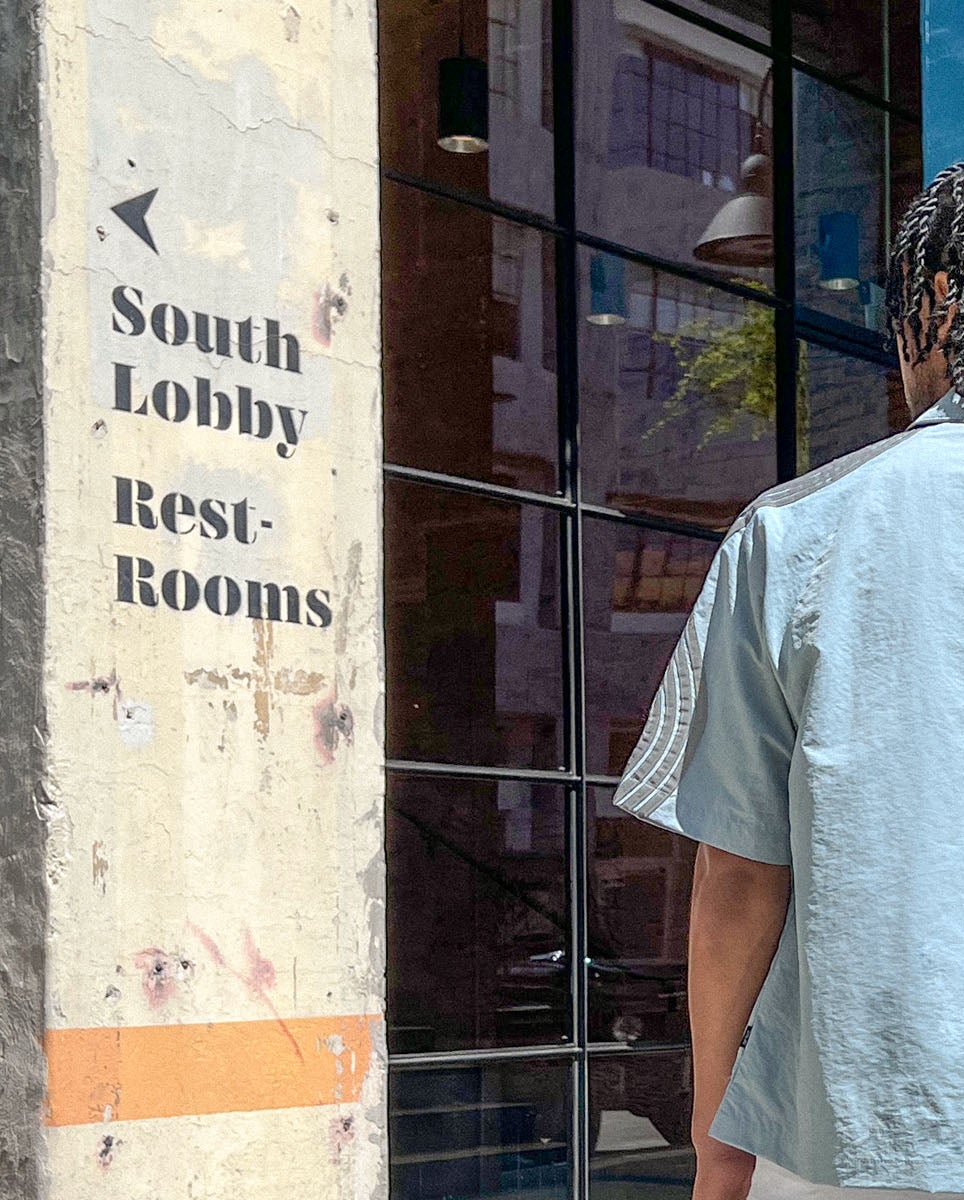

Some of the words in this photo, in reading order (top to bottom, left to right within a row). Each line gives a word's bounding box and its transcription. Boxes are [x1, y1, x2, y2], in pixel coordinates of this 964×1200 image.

[111, 285, 303, 375] South
[111, 362, 309, 459] Lobby
[112, 475, 273, 545] Rest-
[113, 554, 333, 628] Rooms
